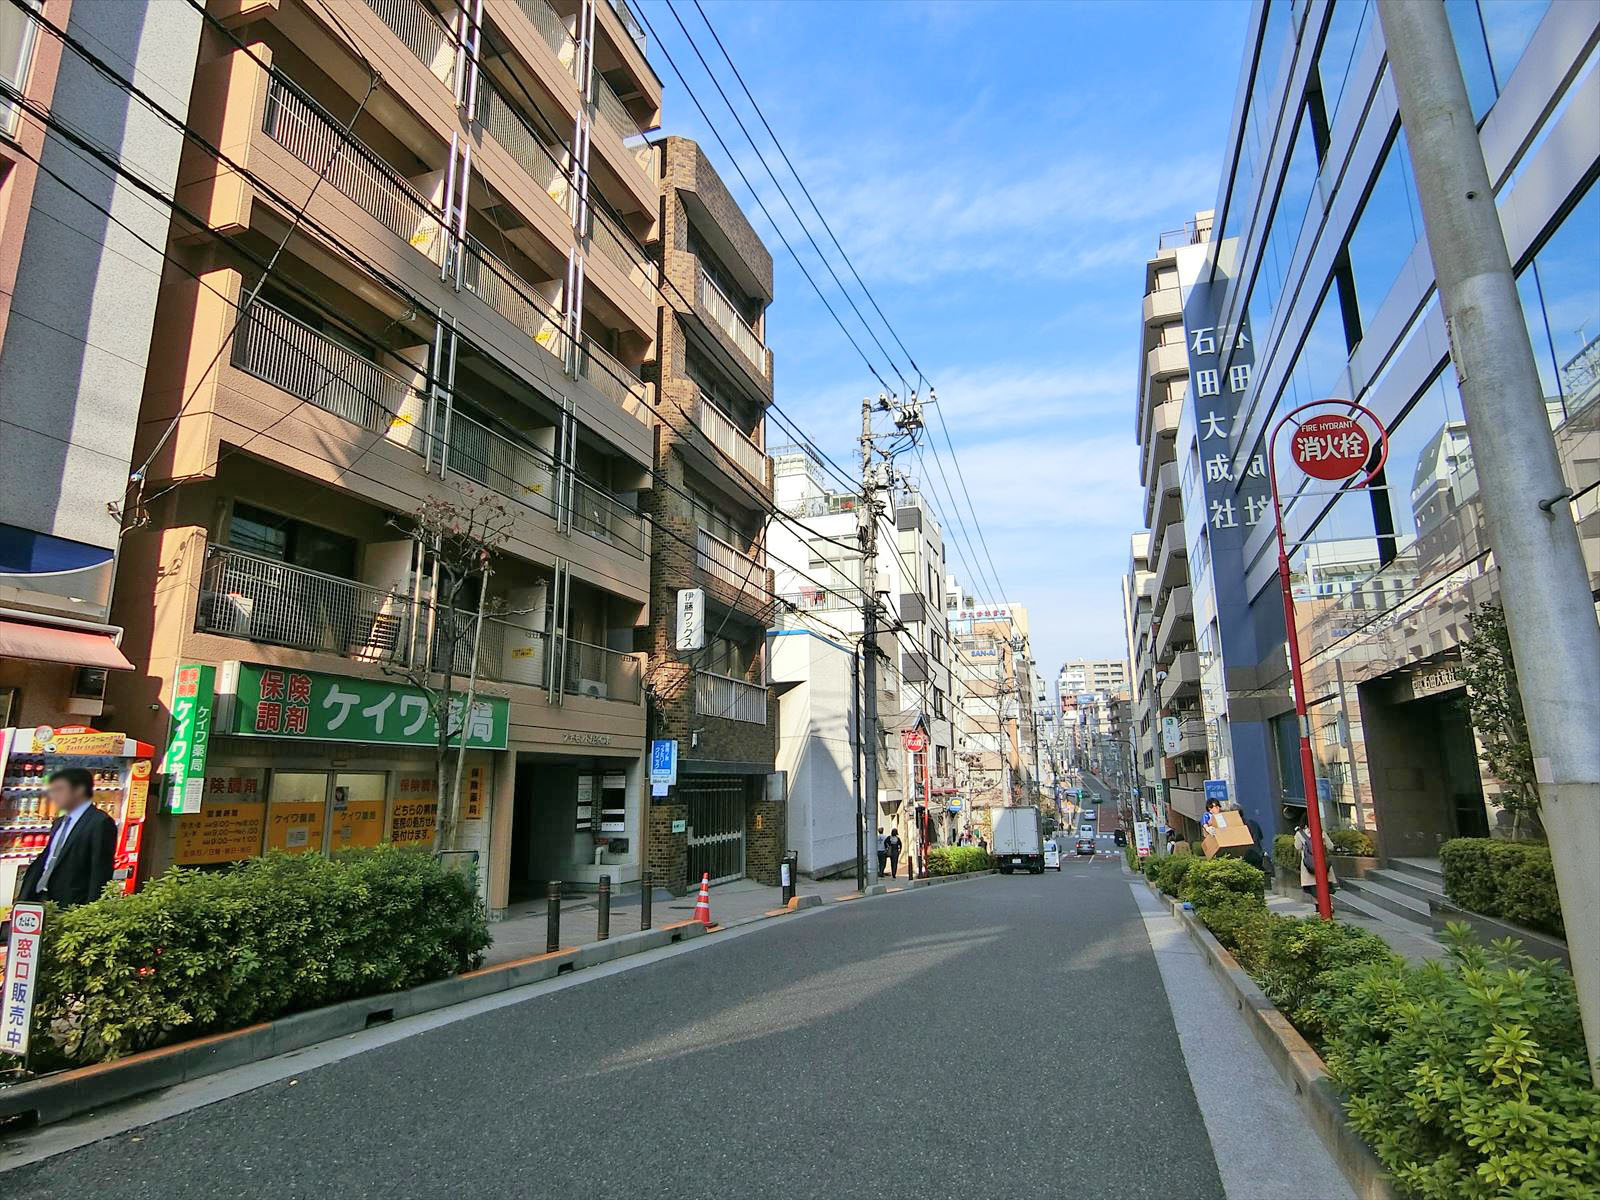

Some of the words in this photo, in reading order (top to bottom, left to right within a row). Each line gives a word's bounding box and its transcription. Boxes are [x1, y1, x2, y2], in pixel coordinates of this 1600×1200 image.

[1190, 327, 1239, 529] 石田大成社
[1301, 424, 1318, 432] FIRE
[1319, 421, 1353, 431] HYDRANT
[1297, 432, 1365, 463] 消火栓
[683, 591, 695, 648] 伊藤ワックス
[260, 669, 313, 704] 保険
[256, 700, 309, 734] 調剤
[190, 705, 210, 772] ケイワ薬局
[19, 916, 36, 928] たばこ
[6, 938, 32, 1048] 窓口販売中
